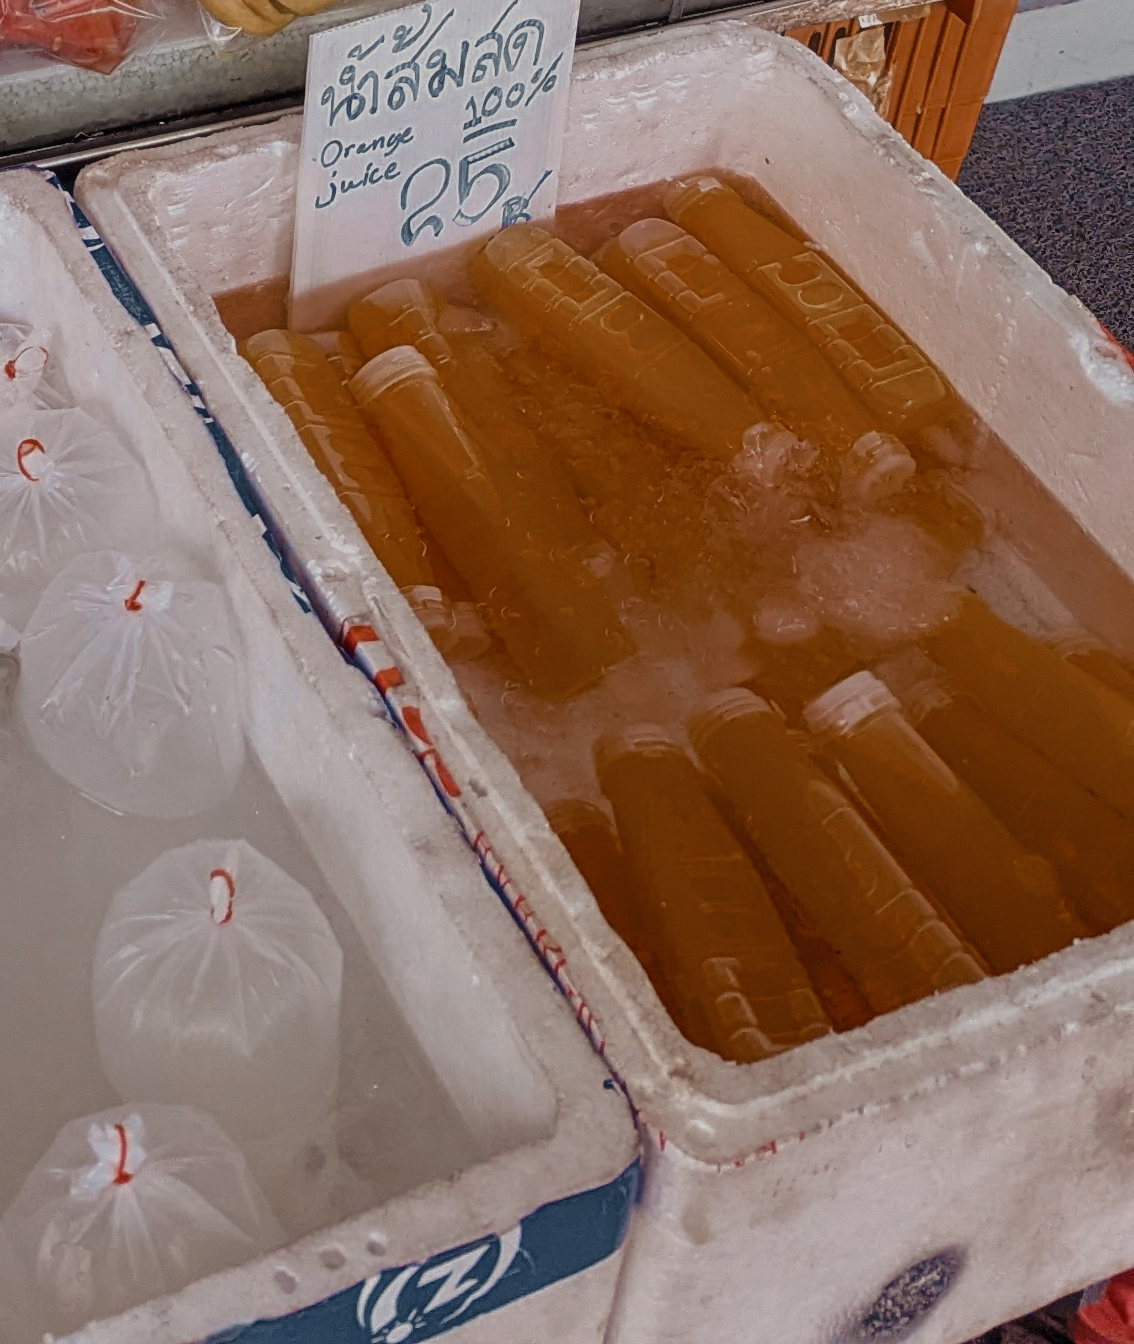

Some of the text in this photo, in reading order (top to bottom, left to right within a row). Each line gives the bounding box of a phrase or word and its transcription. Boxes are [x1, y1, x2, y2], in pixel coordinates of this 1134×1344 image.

[463, 52, 563, 131] 100%
[320, 126, 414, 169] Orange
[314, 162, 401, 209] juice
[400, 136, 516, 247] 25
